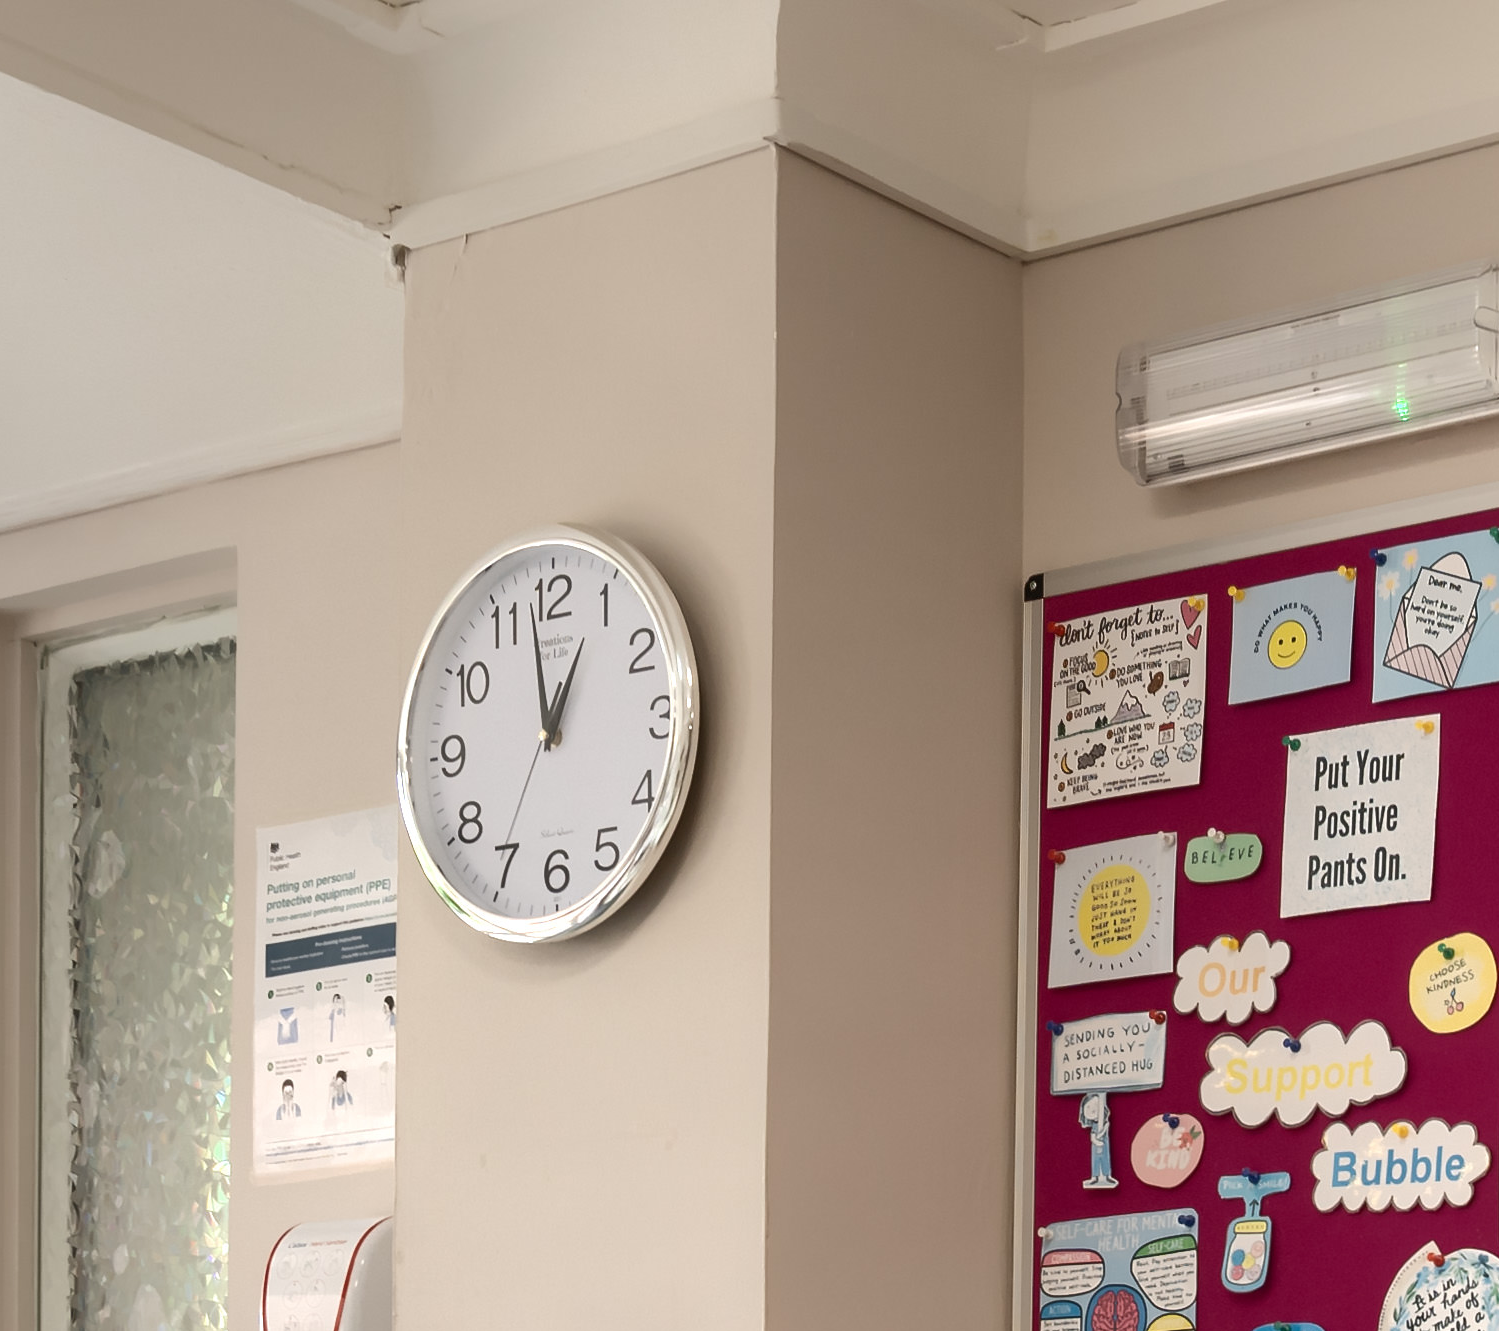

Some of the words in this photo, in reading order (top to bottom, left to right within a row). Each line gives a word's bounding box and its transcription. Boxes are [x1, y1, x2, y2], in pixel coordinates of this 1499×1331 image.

[535, 574, 573, 622] 12
[600, 582, 609, 627] 1
[491, 602, 517, 649] 11
[537, 633, 574, 649] reations
[1253, 640, 1261, 653] DO
[1257, 615, 1273, 638] WHAT
[1273, 603, 1298, 617] MAKES
[1299, 603, 1313, 616] YOU
[1311, 613, 1322, 642] HAPPY
[553, 646, 569, 659] Life
[628, 628, 655, 674] 2
[456, 661, 490, 707] 10
[648, 695, 671, 739] 3
[440, 735, 466, 777] 9
[1315, 755, 1349, 791] Put
[1357, 749, 1405, 785] Your
[631, 770, 655, 813] 4
[457, 801, 483, 844] 8
[1314, 799, 1398, 840] Positive
[495, 843, 519, 888] 7
[594, 827, 620, 871] 5
[1308, 853, 1367, 890] Pants
[1374, 847, 1406, 882] On.
[267, 882, 299, 895] Putting
[302, 878, 314, 888] on
[316, 869, 356, 888] personal
[544, 850, 570, 893] 6
[266, 894, 312, 912] protective
[315, 884, 363, 903] equipment
[366, 879, 391, 895] (PPE)
[1198, 962, 1266, 997] Our
[1426, 969, 1475, 994] KINDNESS
[1429, 958, 1466, 981] CHOOSE
[1063, 1053, 1070, 1064] A
[1076, 1041, 1145, 1061] SOCIALLY-
[1064, 1025, 1115, 1047] SENDING
[1122, 1023, 1151, 1036] YOU
[1064, 1060, 1126, 1083] DISTANCED
[1132, 1058, 1153, 1072] HUG
[1224, 1053, 1374, 1100] Support
[1160, 1127, 1183, 1149] BE
[1146, 1149, 1190, 1171] KIND
[1331, 1146, 1465, 1188] Bubble
[1428, 1289, 1440, 1301] is
[1442, 1278, 1456, 1291] in
[1441, 1276, 1478, 1309] hands
[1434, 1309, 1463, 1331] make
[1466, 1292, 1479, 1309] of
[1475, 1312, 1485, 1323] a
